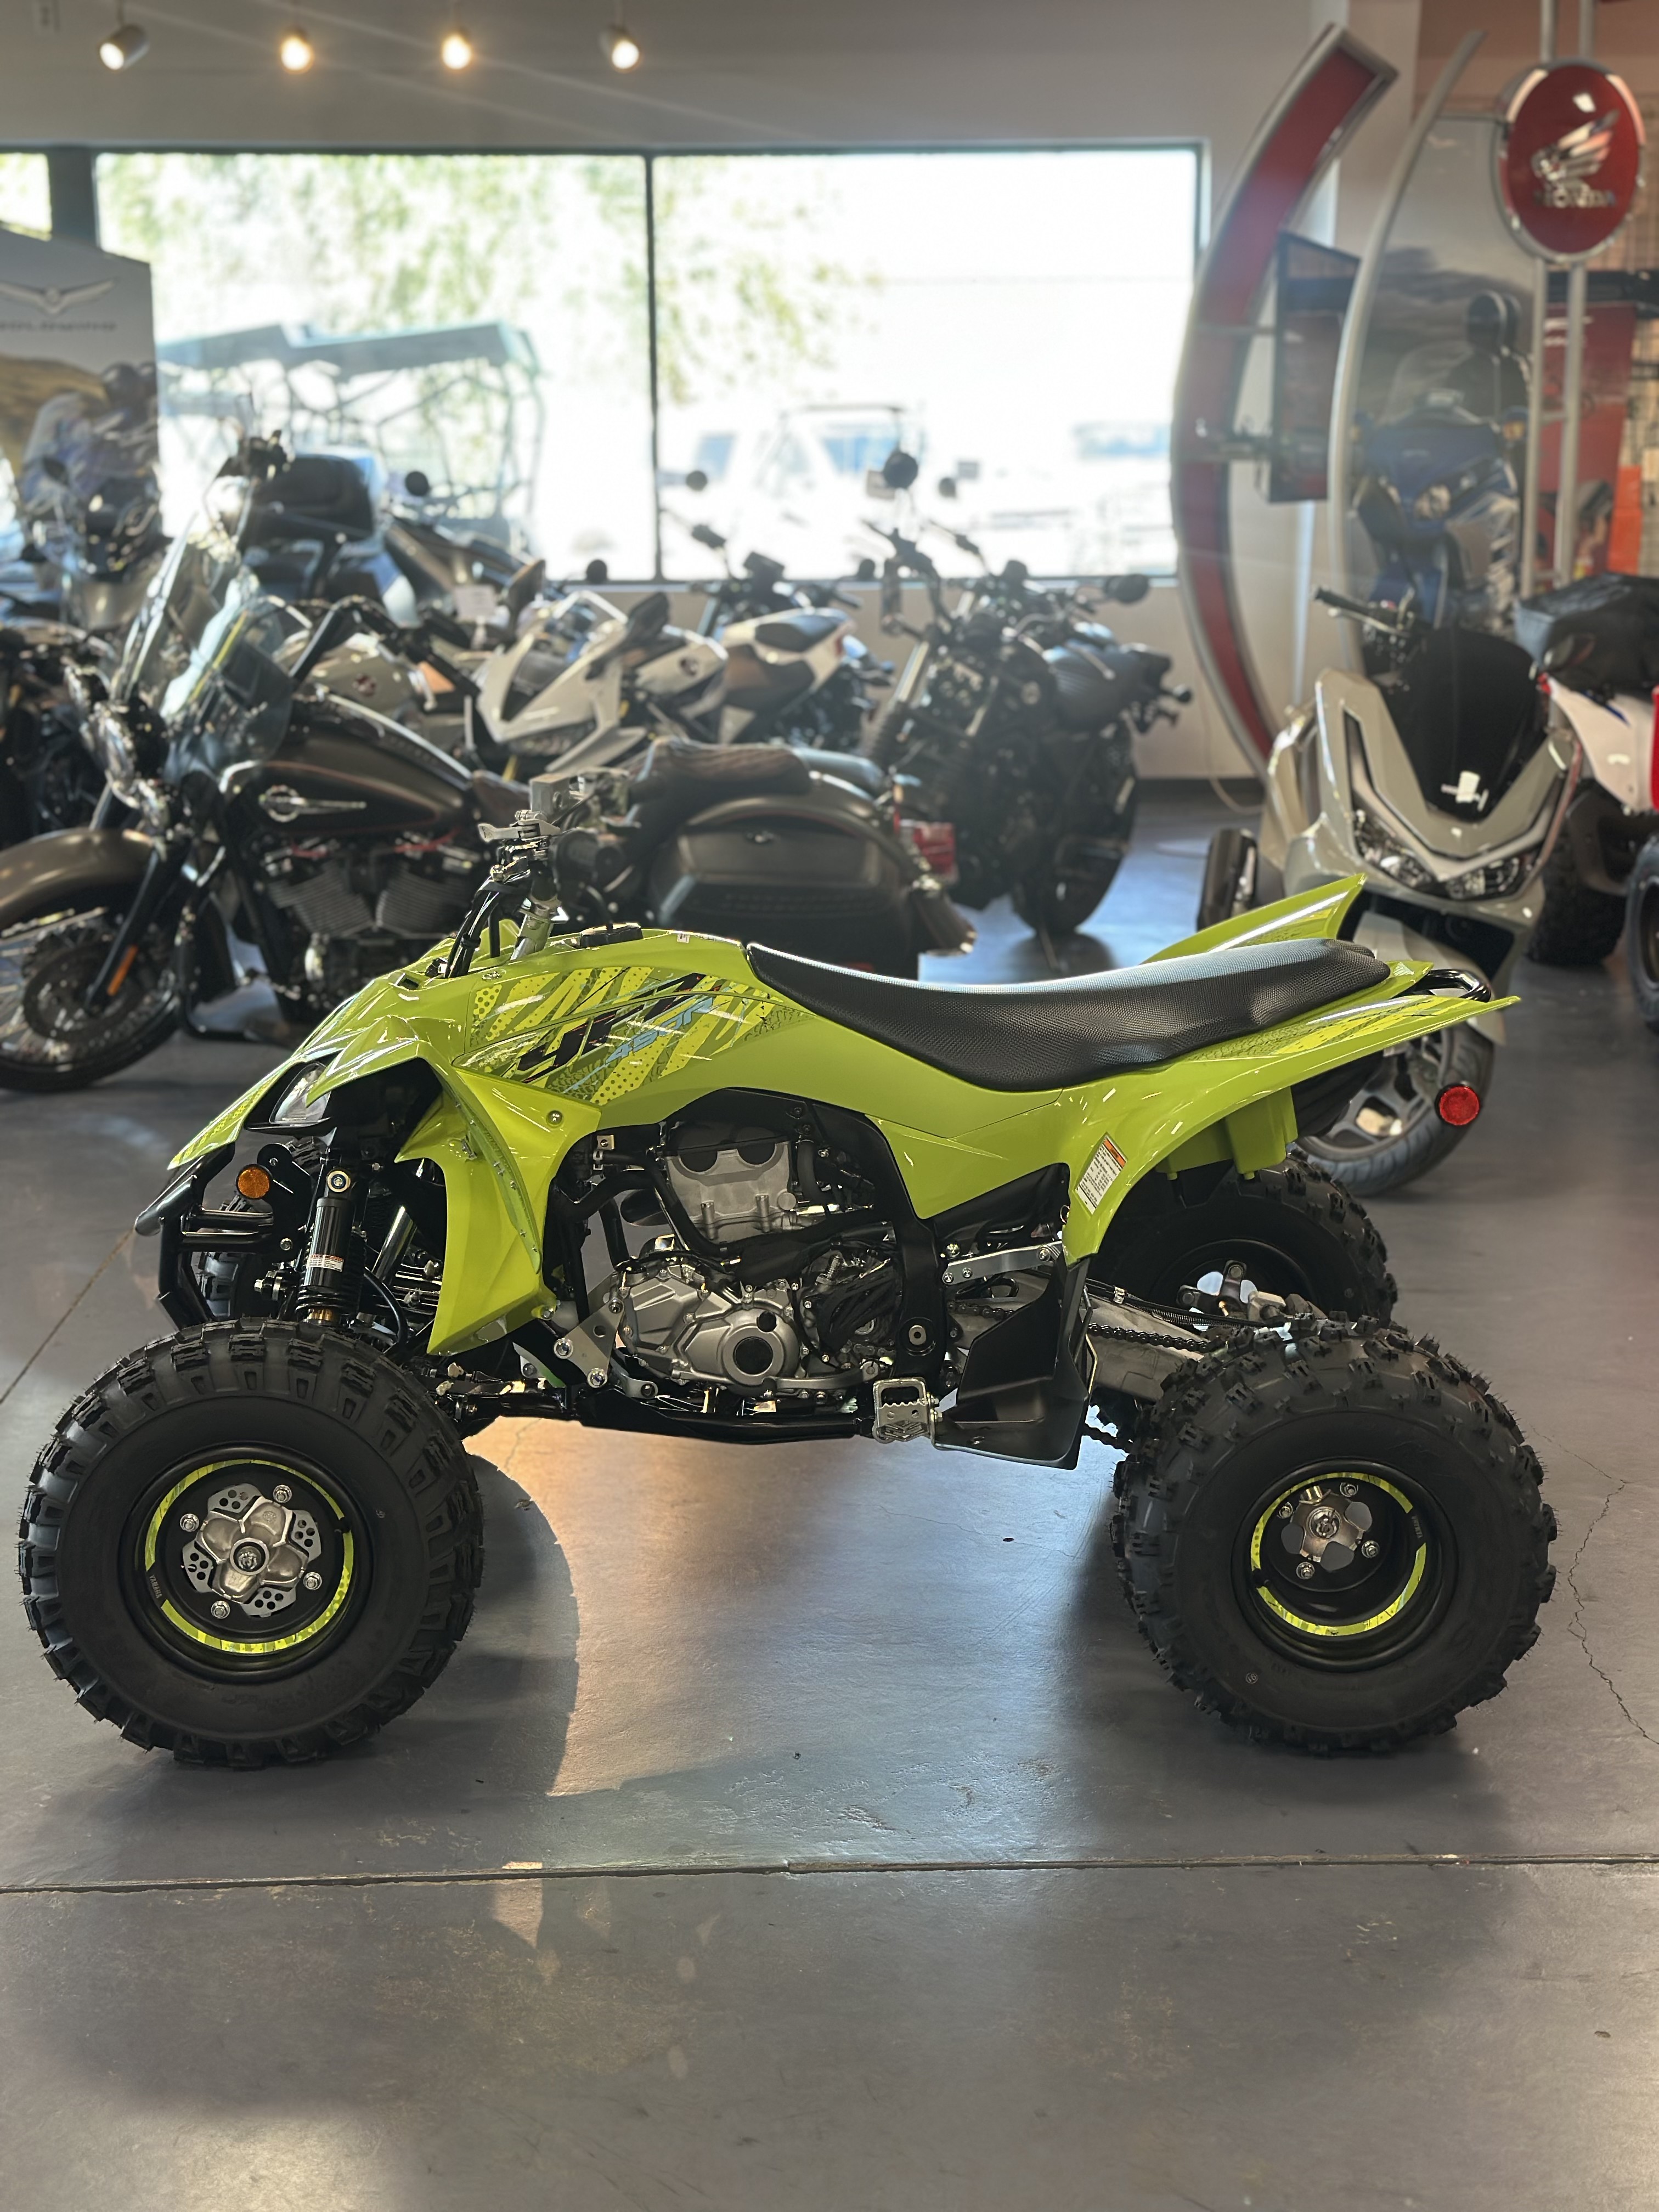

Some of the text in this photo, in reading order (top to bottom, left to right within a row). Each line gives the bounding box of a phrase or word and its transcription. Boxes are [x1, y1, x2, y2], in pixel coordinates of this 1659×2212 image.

[1533, 189, 1616, 208] HONDA
[605, 994, 714, 1065] 450R
[149, 1575, 162, 1598] YAMAHA
